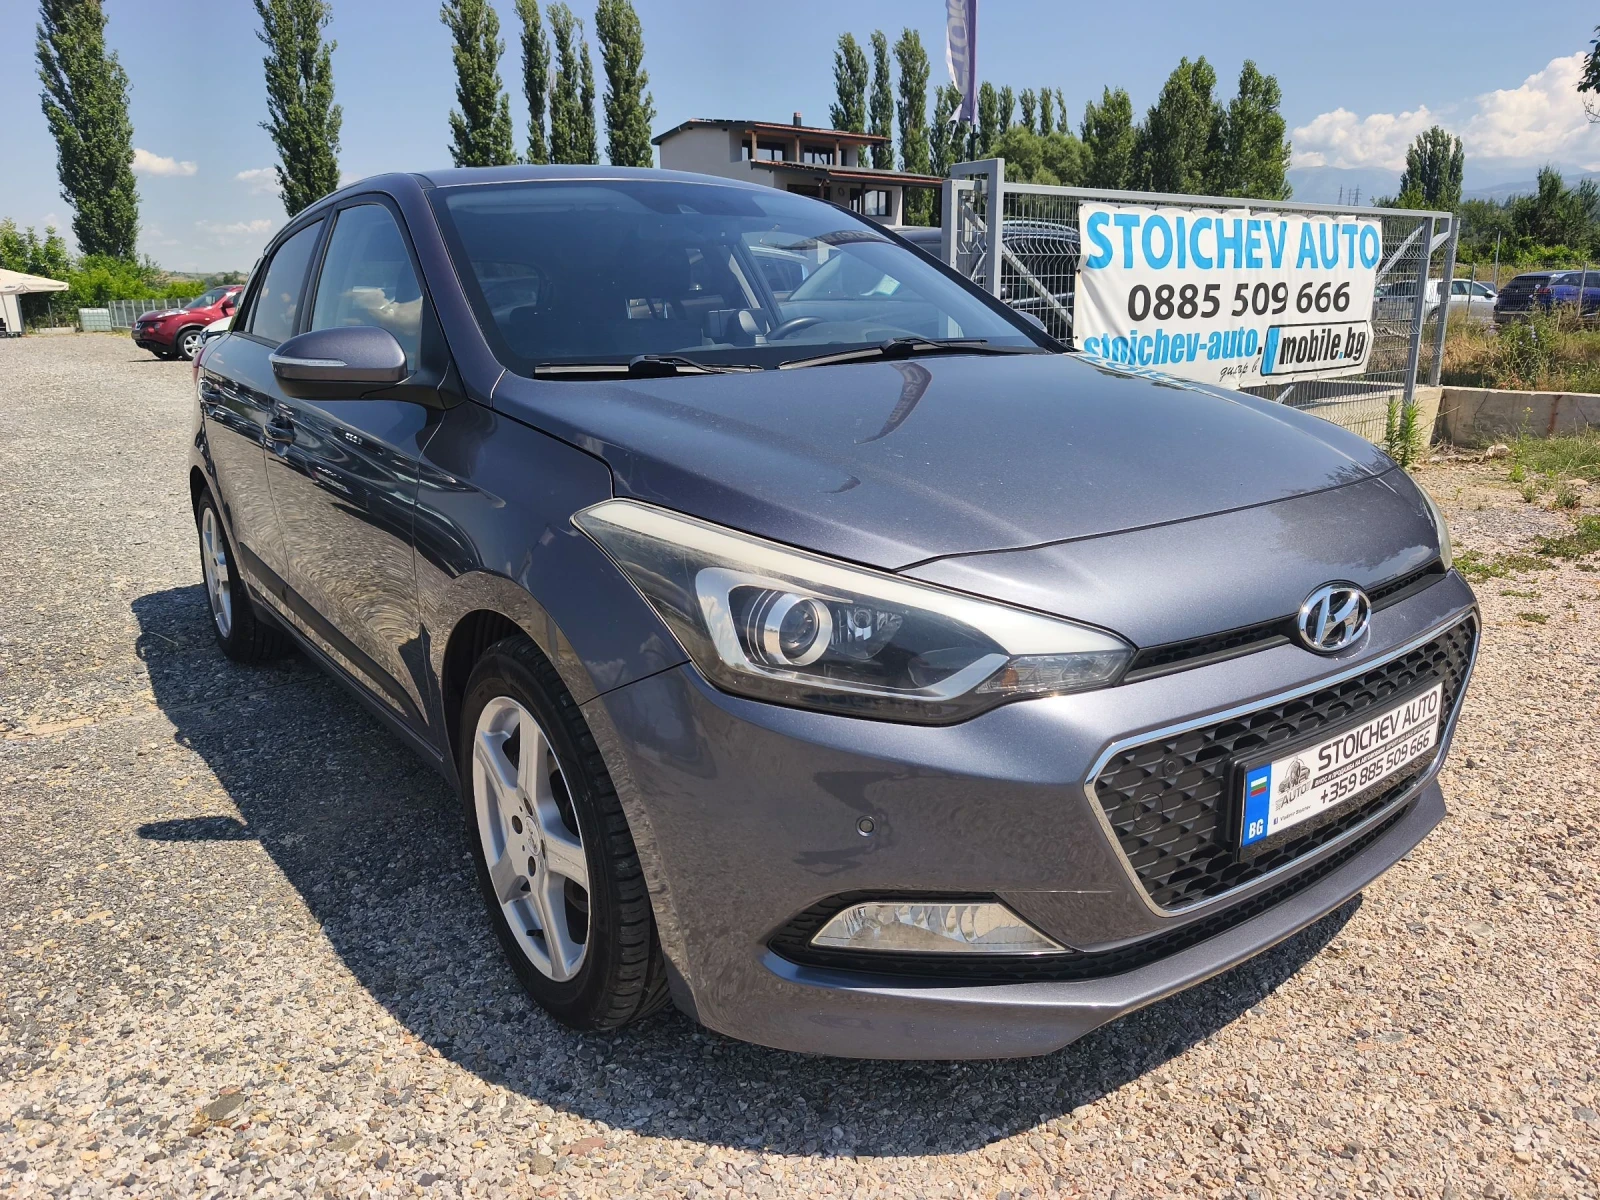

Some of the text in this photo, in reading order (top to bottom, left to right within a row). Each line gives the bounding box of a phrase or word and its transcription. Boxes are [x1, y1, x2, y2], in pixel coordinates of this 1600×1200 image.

[1085, 211, 1380, 269] STOICHEV AUTO
[1128, 281, 1350, 321] 0885 509 666
[1279, 327, 1366, 365] mobile.bg
[1318, 710, 1400, 771] STOICHEV
[1402, 690, 1437, 729] AUTO
[1320, 772, 1357, 803] +359
[1360, 757, 1384, 786] 885
[1385, 744, 1408, 771] 509
[1409, 730, 1430, 756] 666
[1280, 784, 1307, 808] AUTO
[1249, 818, 1264, 839] BG
